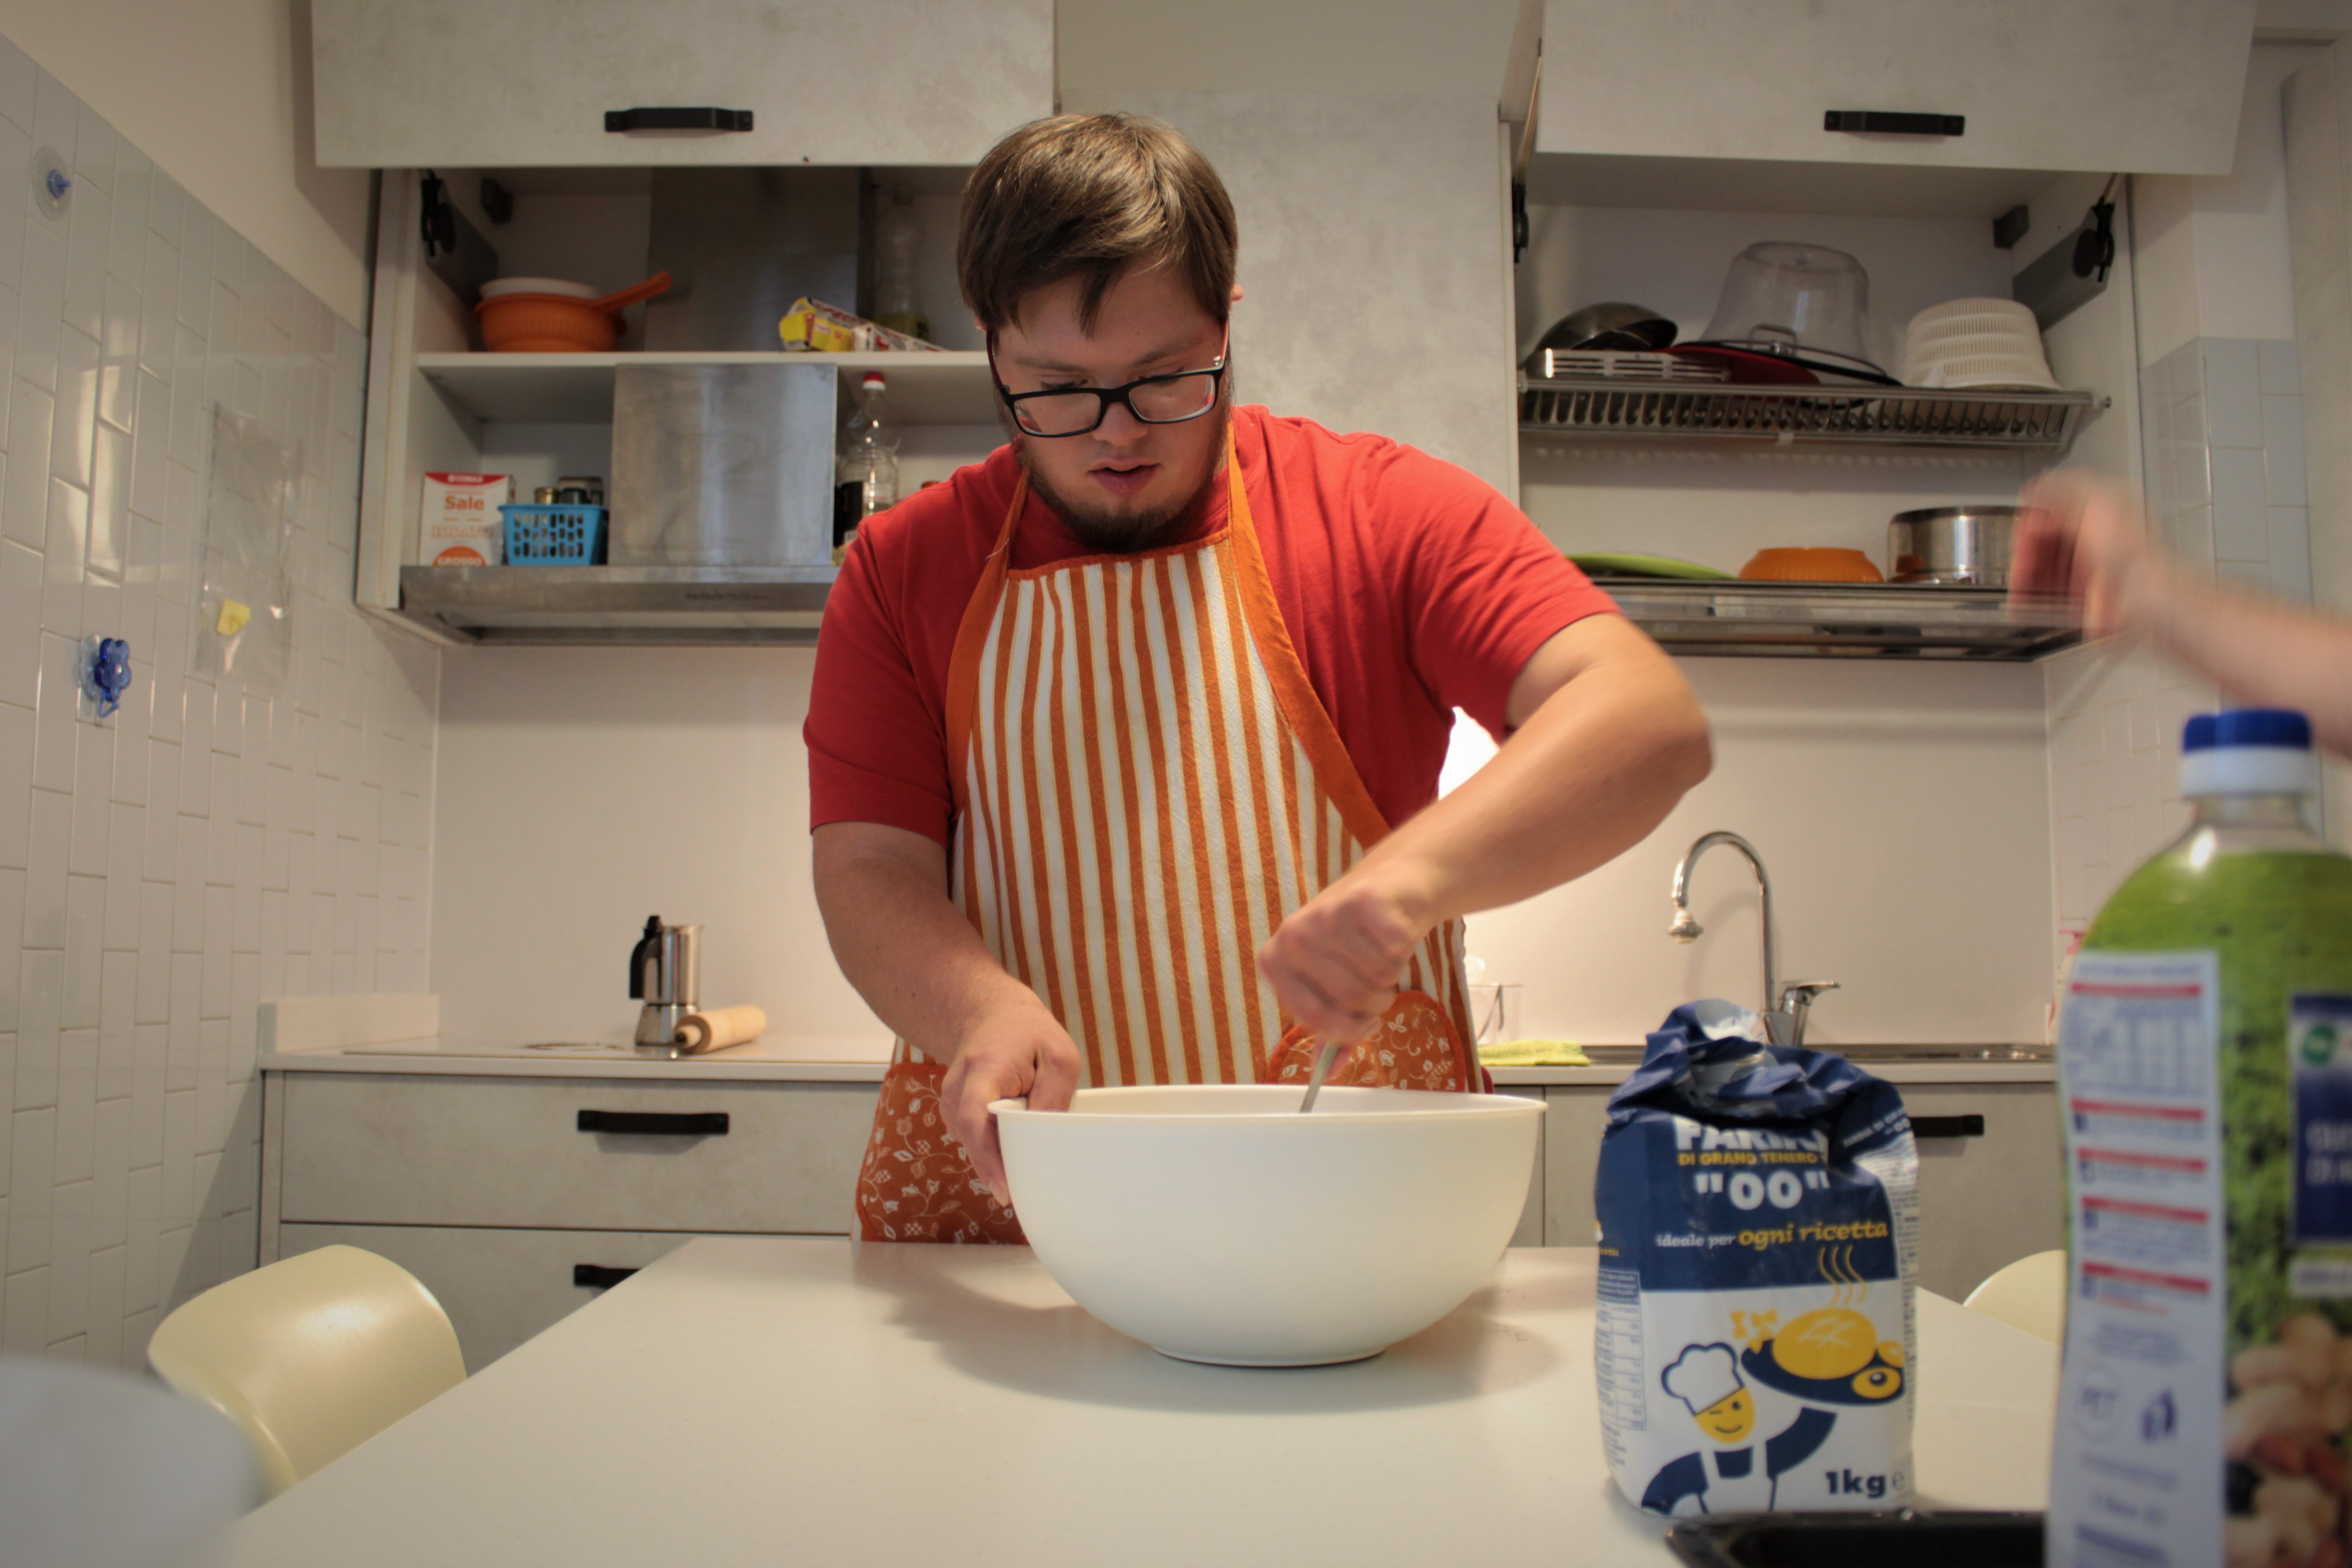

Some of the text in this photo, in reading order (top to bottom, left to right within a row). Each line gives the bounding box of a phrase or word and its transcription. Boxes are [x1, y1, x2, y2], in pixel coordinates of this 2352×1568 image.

[445, 496, 485, 511] Sale
[1672, 1113, 1829, 1151] FARIN
[1678, 1152, 1819, 1166] DI GRANO TENERO
[1657, 1220, 1889, 1250] ideale per ogni ricetta
[1826, 1468, 1886, 1500] 1kg
